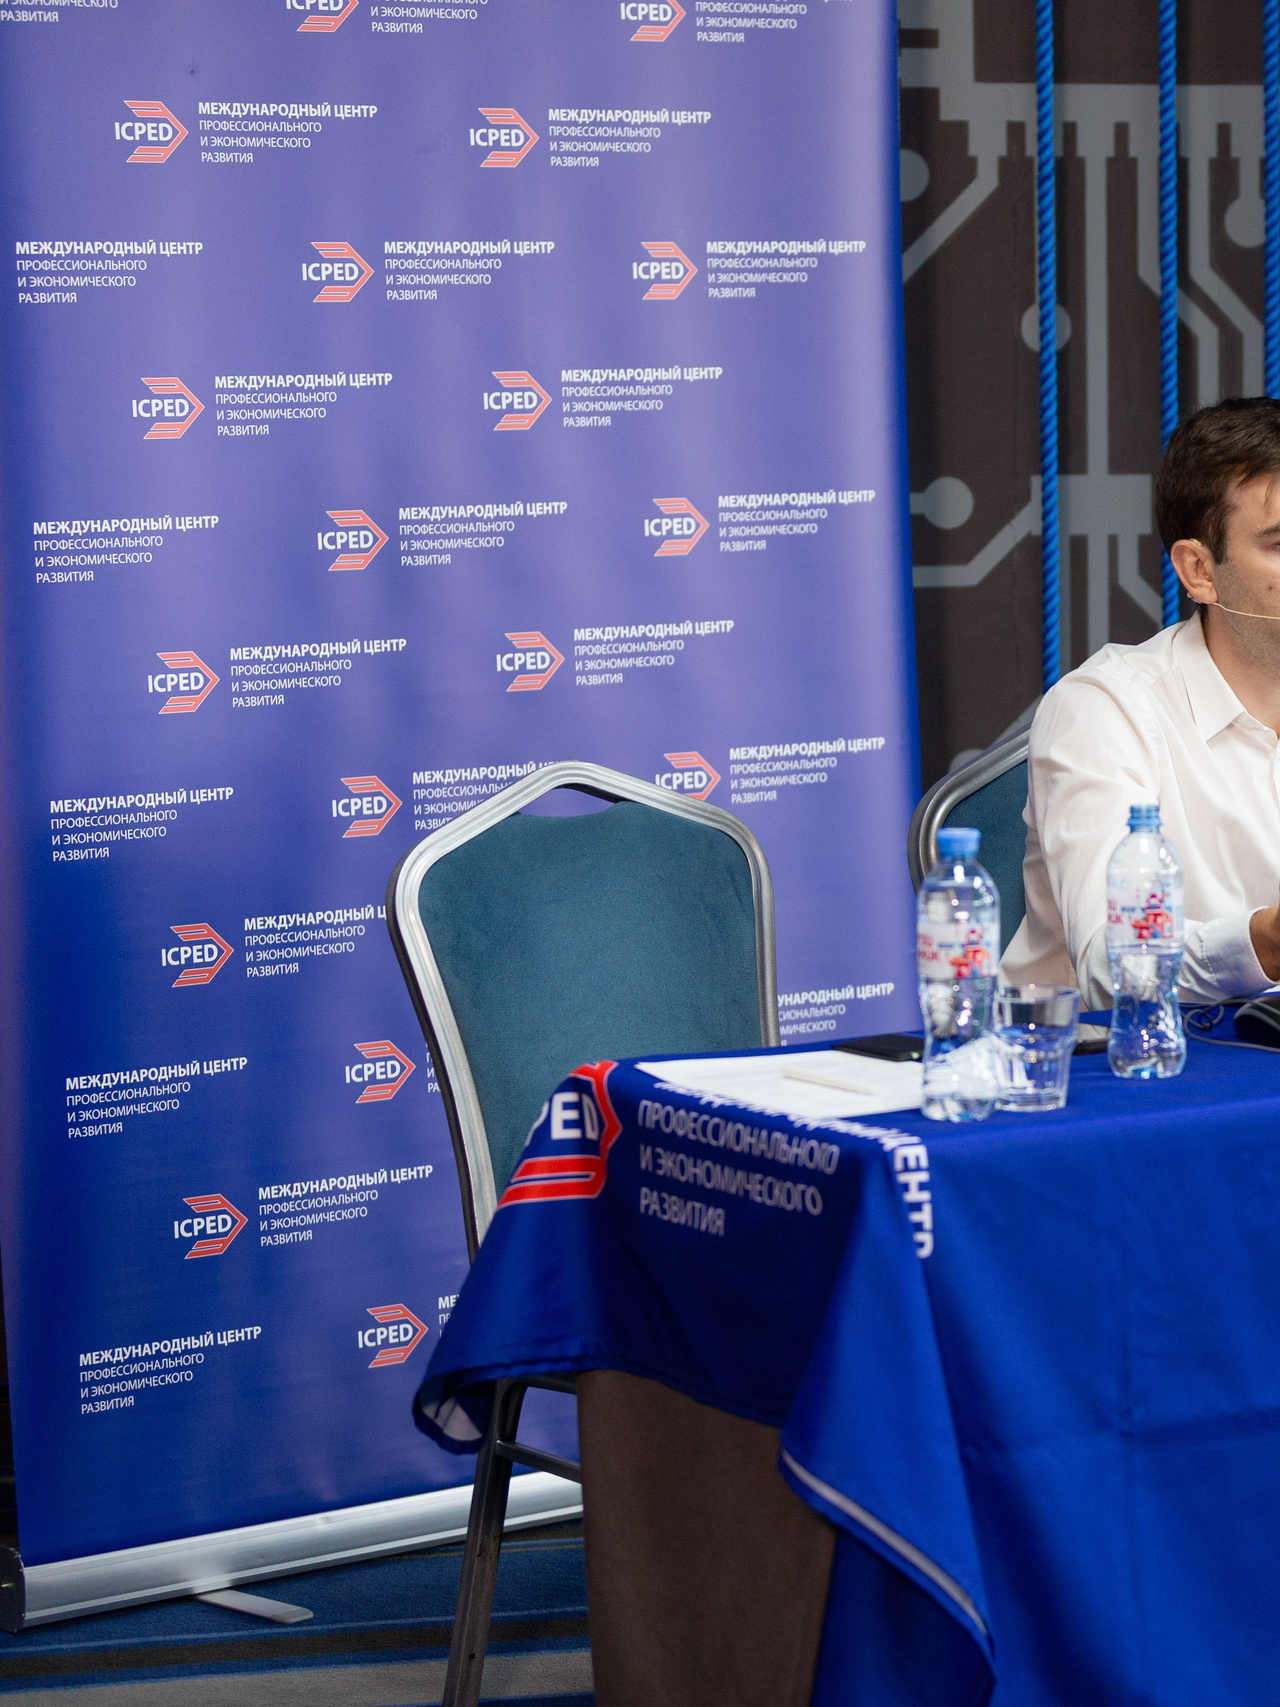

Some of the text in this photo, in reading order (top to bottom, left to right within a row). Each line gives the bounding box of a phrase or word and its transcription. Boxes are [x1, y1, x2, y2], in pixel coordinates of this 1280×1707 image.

[0, 9, 58, 22] РАЗВИТИЯ
[370, 6, 477, 19] И ЭКОНОМИЧЕСКОГО
[620, 2, 673, 22] ICPED
[371, 21, 423, 33] РАЗВИТИЯ
[198, 101, 377, 120] МЕЖДУНАРОДНЫЙ ЦЕНТР
[548, 108, 711, 125] МЕЖДУНАРОДНЫЙ ЦЕНТР
[115, 121, 173, 142] ICPED
[198, 119, 321, 132] ПРОФЕССИОНАЛЬНОГО
[548, 125, 661, 137] ПРОФЕССИОНАЛЬНОГО
[199, 135, 311, 148] И ЭКОНОМИЧЕСКОГО
[469, 128, 525, 147] ICPED
[549, 140, 651, 152] И ЭКОНОМИЧЕСКОГО
[200, 151, 253, 163] РАЗВИТИЯ
[550, 155, 599, 166] РАЗВИТИЯ
[15, 238, 203, 257] МЕЖДУНАРОДНЫЙ ЦЕНТР
[384, 238, 555, 256] МЕЖДУНАРОДНЫЙ ЦЕНТР
[706, 238, 866, 255] МЕЖДУНАРОДНЫЙ ЦЕНТР
[15, 259, 147, 270] ПРОФЕССИОНАЛЬНОГО
[302, 261, 359, 282] ICPED
[384, 258, 501, 269] ПРОФЕССИОНАЛЬНОГО
[632, 261, 684, 280] ICPED
[17, 275, 136, 287] И ЭКОНОМИЧЕСКОГО
[385, 273, 491, 285] И ЭКОНОМИЧЕСКОГО
[18, 291, 77, 303] РАЗВИТИЯ
[386, 289, 437, 300] РАЗВИТИЯ
[214, 371, 392, 390] МЕЖДУНАРОДНЫЙ ЦЕНТР
[560, 364, 723, 384] МЕЖДУНАРОДНЫЙ ЦЕНТР
[215, 391, 337, 404] ПРОФЕССИОНАЛЬНОГО
[561, 384, 673, 397] ПРОФЕССИОНАЛЬНОГО
[132, 398, 189, 418] ICPED
[483, 391, 538, 410] ICPED
[562, 399, 663, 412] И ЭКОНОМИЧЕСКОГО
[216, 407, 326, 420] И ЭКОНОМИЧЕСКОГО
[563, 415, 611, 427] РАЗВИТИЯ
[217, 424, 269, 436] РАЗВИТИЯ
[717, 488, 875, 508] МЕЖДУНАРОДНЫЙ ЦЕНТР
[398, 500, 567, 521] МЕЖДУНАРОДНЫЙ ЦЕНТР
[32, 514, 219, 536] МЕЖДУНАРОДНЫЙ ЦЕНТР
[399, 520, 515, 535] ПРОФЕССИОНАЛЬНОГО
[644, 516, 696, 536] ICPED
[33, 535, 163, 551] ПРОФЕССИОНАЛЬНОГО
[317, 529, 374, 551] ICPED
[400, 536, 504, 551] И ЭКОНОМИЧЕСКОГО
[34, 551, 152, 567] И ЭКОНОМИЧЕСКОГО
[400, 553, 451, 566] РАЗВИТИЯ
[35, 570, 94, 583] РАЗВИТИЯ
[573, 619, 734, 641] МЕЖДУНАРОДНЫЙ ЦЕНТР
[229, 638, 406, 661] МЕЖДУНАРОДНЫЙ ЦЕНТР
[574, 639, 684, 655] ПРОФЕССИОНАЛЬНОГО
[230, 658, 351, 676] ПРОФЕССИОНАЛЬНОГО
[496, 651, 551, 672] ICPED
[575, 654, 674, 671] И ЭКОНОМИЧЕСКОГО
[147, 671, 204, 693] ICPED
[231, 674, 341, 692] И ЭКОНОМИЧЕСКОГО
[575, 672, 623, 685] РАЗВИТИЯ
[232, 693, 284, 708] РАЗВИТИЯ
[729, 736, 885, 760] МЕЖДУНАРОДНЫЙ ЦЕНТР
[412, 760, 536, 785] МЕЖДУНАРОДНЫЙ
[729, 756, 837, 774] ПРОФЕССИОНАЛЬНОГО
[730, 771, 827, 789] И ЭКОНОМИЧЕСКОГО
[49, 786, 234, 813] МЕЖДУНАРОДНЫЙ ЦЕНТР
[731, 789, 777, 803] РАЗВИТИЯ
[332, 795, 388, 818] ICPED
[50, 809, 177, 829] ПРОФЕССИОНАЛЬНОГО
[51, 825, 166, 845] И ЭКОНОМИЧЕСКОГО
[52, 846, 109, 862] РАЗВИТИЯ
[244, 903, 374, 931] МЕЖДУНАРОДНЫЙ
[244, 924, 365, 946] ПРОФЕССИОНАЛЬНОГО
[161, 943, 219, 967] ICPED
[245, 941, 355, 962] И ЭКОНОМИЧЕСКОГО
[246, 961, 299, 978] РАЗВИТИЯ
[65, 1056, 248, 1090] МЕЖДУНАРОДНЫЙ ЦЕНТР
[345, 1060, 401, 1084] ICPED
[66, 1081, 190, 1106] ПРОФЕССИОНАЛЬНОГО
[66, 1098, 180, 1122] И ЭКОНОМИЧЕСКОГО
[67, 1121, 123, 1138] РАЗВИТИЯ
[639, 1143, 654, 1171] И
[258, 1164, 433, 1200] МЕЖДУНАРОДНЫЙ ЦЕНТР
[258, 1189, 378, 1215] ПРОФЕССИОНАЛЬНОГО
[259, 1205, 368, 1231] И ЭКОНОМИЧЕСКОГО
[639, 1187, 726, 1237] РАЗВИТИЯ
[174, 1213, 233, 1239] ICPED
[260, 1229, 312, 1247] РАЗВИТИЯ
[358, 1323, 414, 1349] ICPED
[79, 1325, 261, 1367] МЕЖДУНАРОДНЫЙ ЦЕНТР
[79, 1352, 204, 1382] ПРОФЕССИОНАЛЬНОГО
[80, 1370, 193, 1399] И ЭКОНОМИЧЕСКОГО
[80, 1395, 134, 1414] РАЗВИТИЯ
